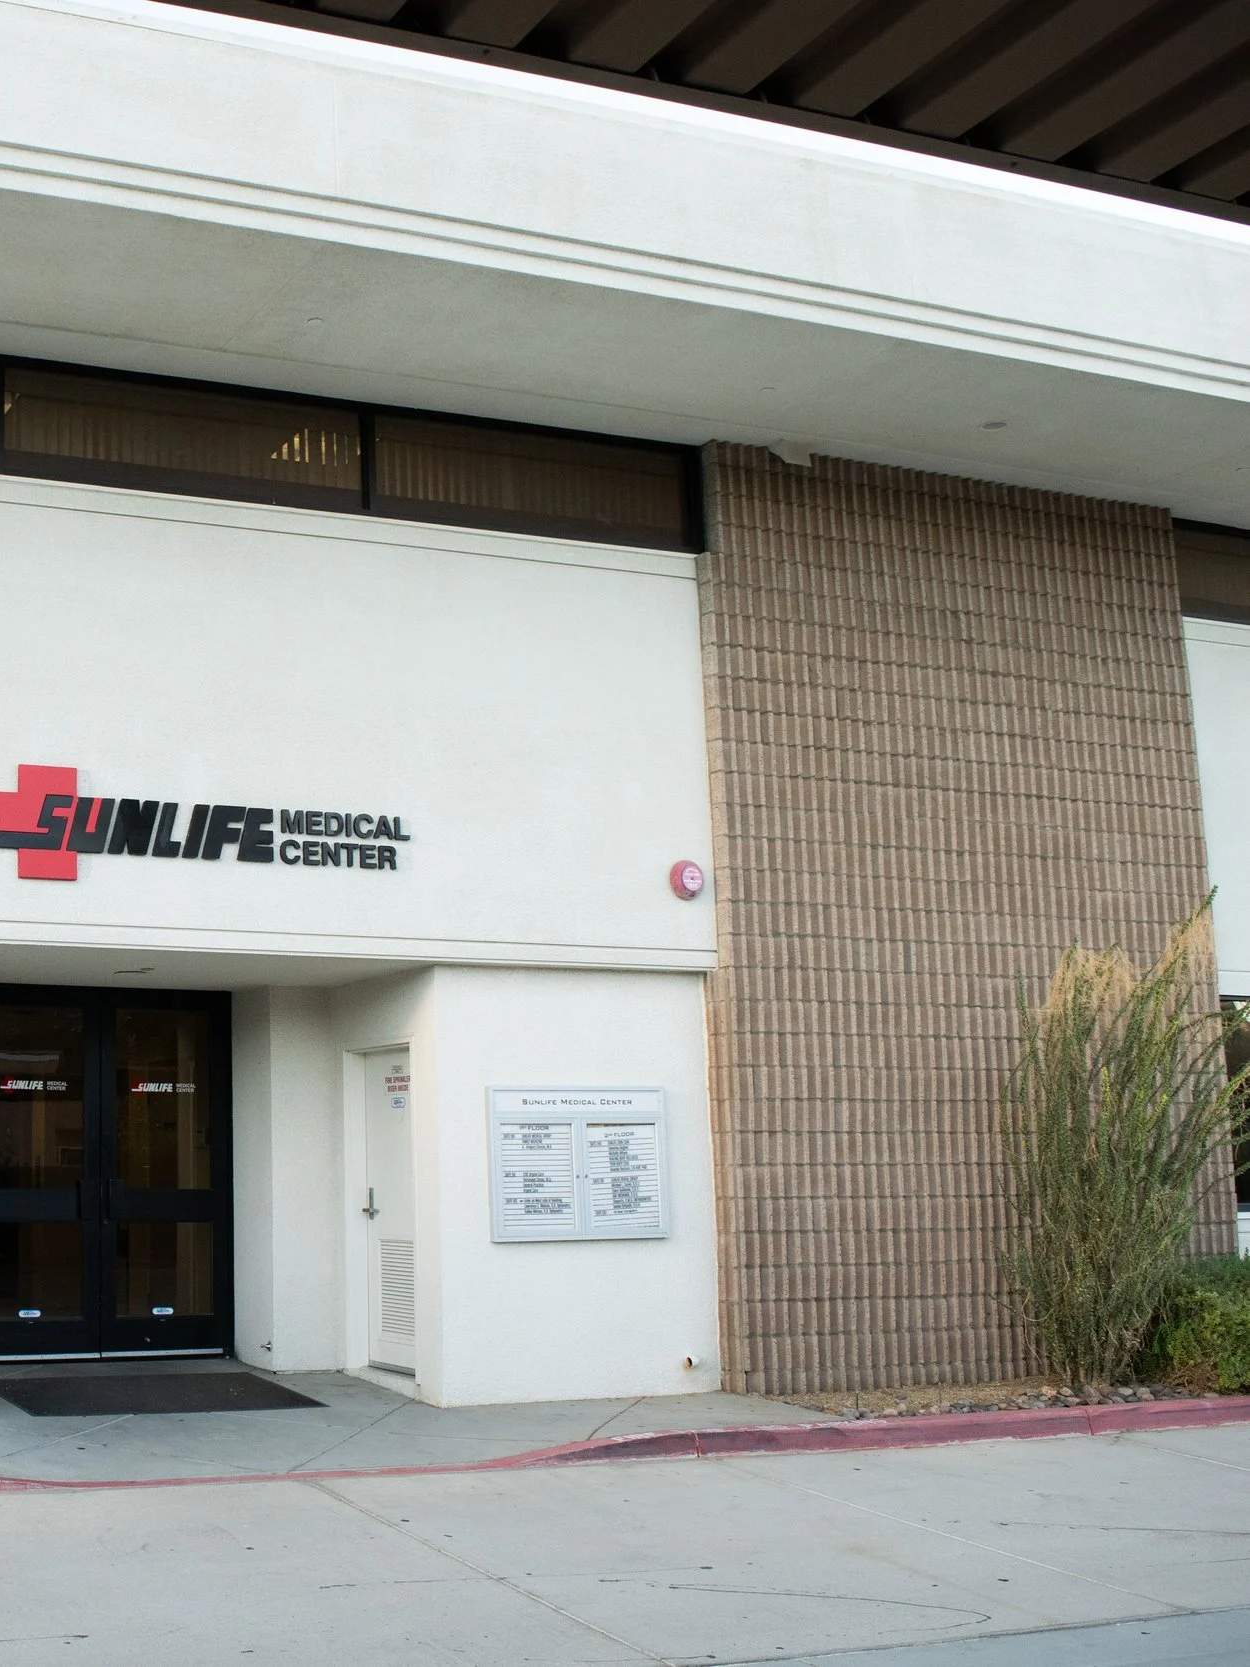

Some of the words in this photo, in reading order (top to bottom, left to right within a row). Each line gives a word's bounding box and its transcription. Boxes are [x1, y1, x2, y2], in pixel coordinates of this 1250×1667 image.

[279, 809, 411, 841] MEDICAL
[278, 839, 398, 871] CENTER
[0, 1080, 43, 1090] SUNLIFE
[132, 1082, 173, 1092] SUNLIFE
